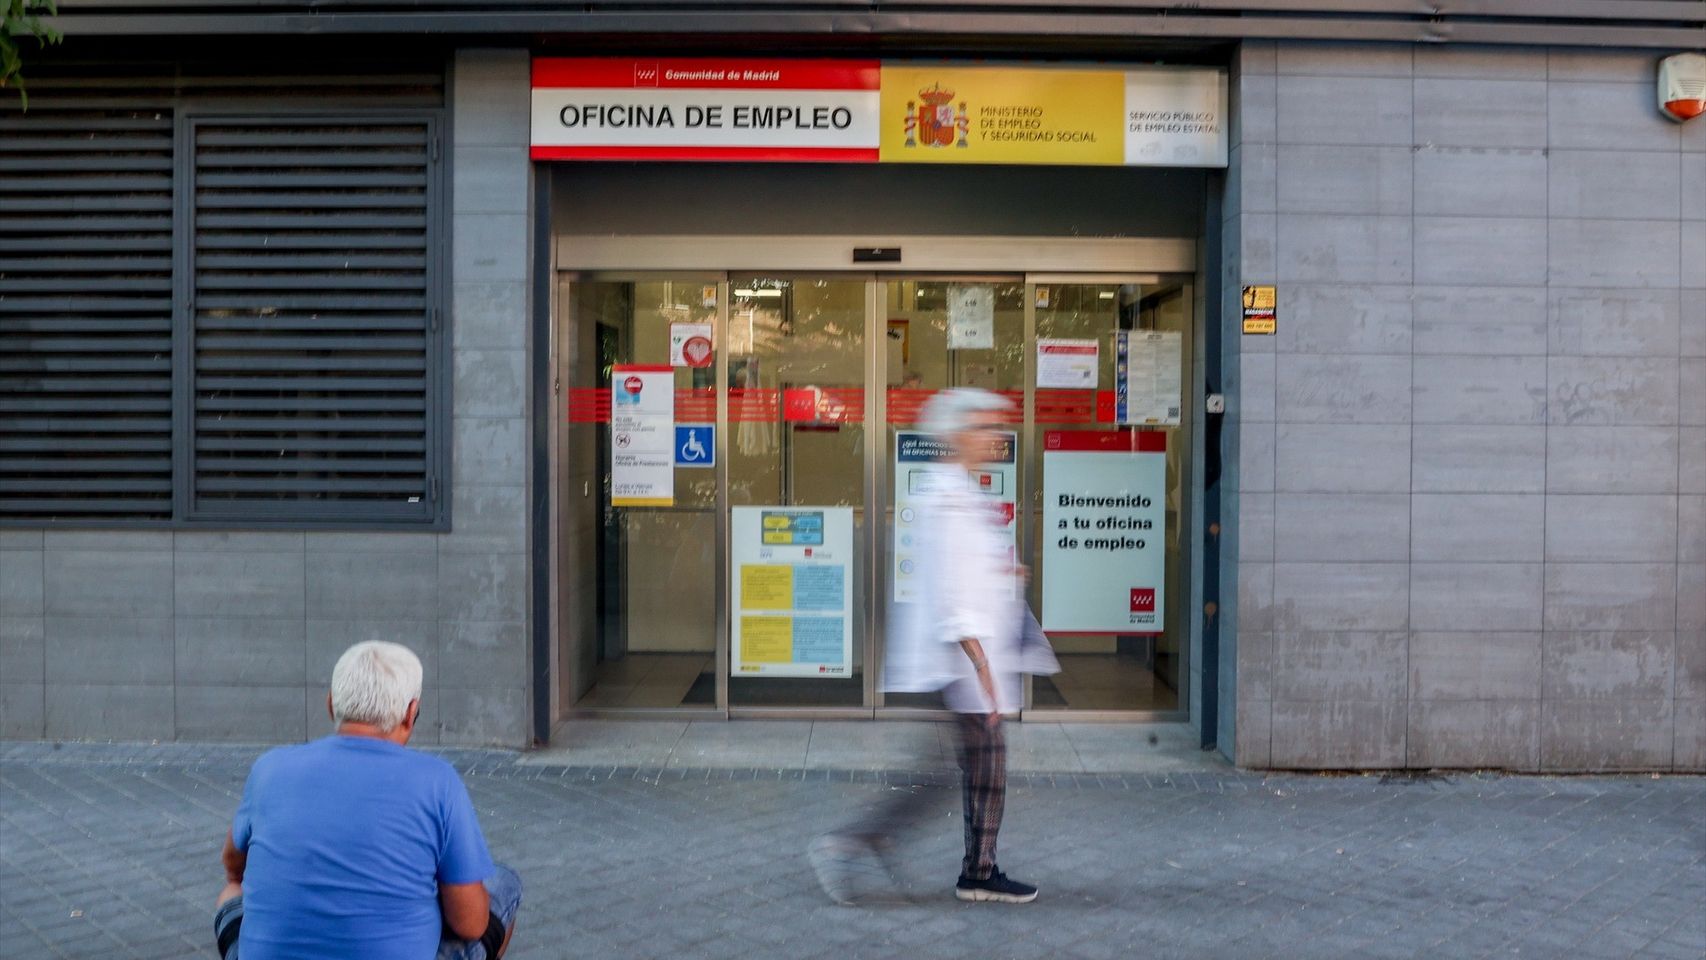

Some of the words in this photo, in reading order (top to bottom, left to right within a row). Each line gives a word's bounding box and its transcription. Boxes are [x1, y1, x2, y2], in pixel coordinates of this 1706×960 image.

[665, 69, 725, 81] Comunidad
[727, 69, 740, 81] de
[743, 69, 780, 81] Madrid
[559, 105, 674, 128] OFICINA
[685, 106, 723, 129] DE
[733, 107, 852, 130] EMPLEO
[980, 106, 1043, 118] MINISTERIO
[1129, 111, 1171, 121] SERVICIO
[980, 119, 996, 130] DE
[998, 119, 1041, 130] EMPLEO
[1129, 123, 1141, 133] DE
[1144, 123, 1180, 133] EMPLEO
[1183, 124, 1220, 134] ESTATAL
[980, 131, 988, 142] Y
[990, 131, 1053, 143] SEGURIDAD
[1056, 132, 1097, 143] SOCIAL
[911, 448, 939, 456] OFICINAS
[1058, 494, 1151, 508] Bienvenido
[1058, 518, 1067, 529] a
[1074, 517, 1090, 529] tu
[1096, 516, 1152, 530] oficina
[1058, 536, 1078, 549] de
[1084, 536, 1146, 552] empleo
